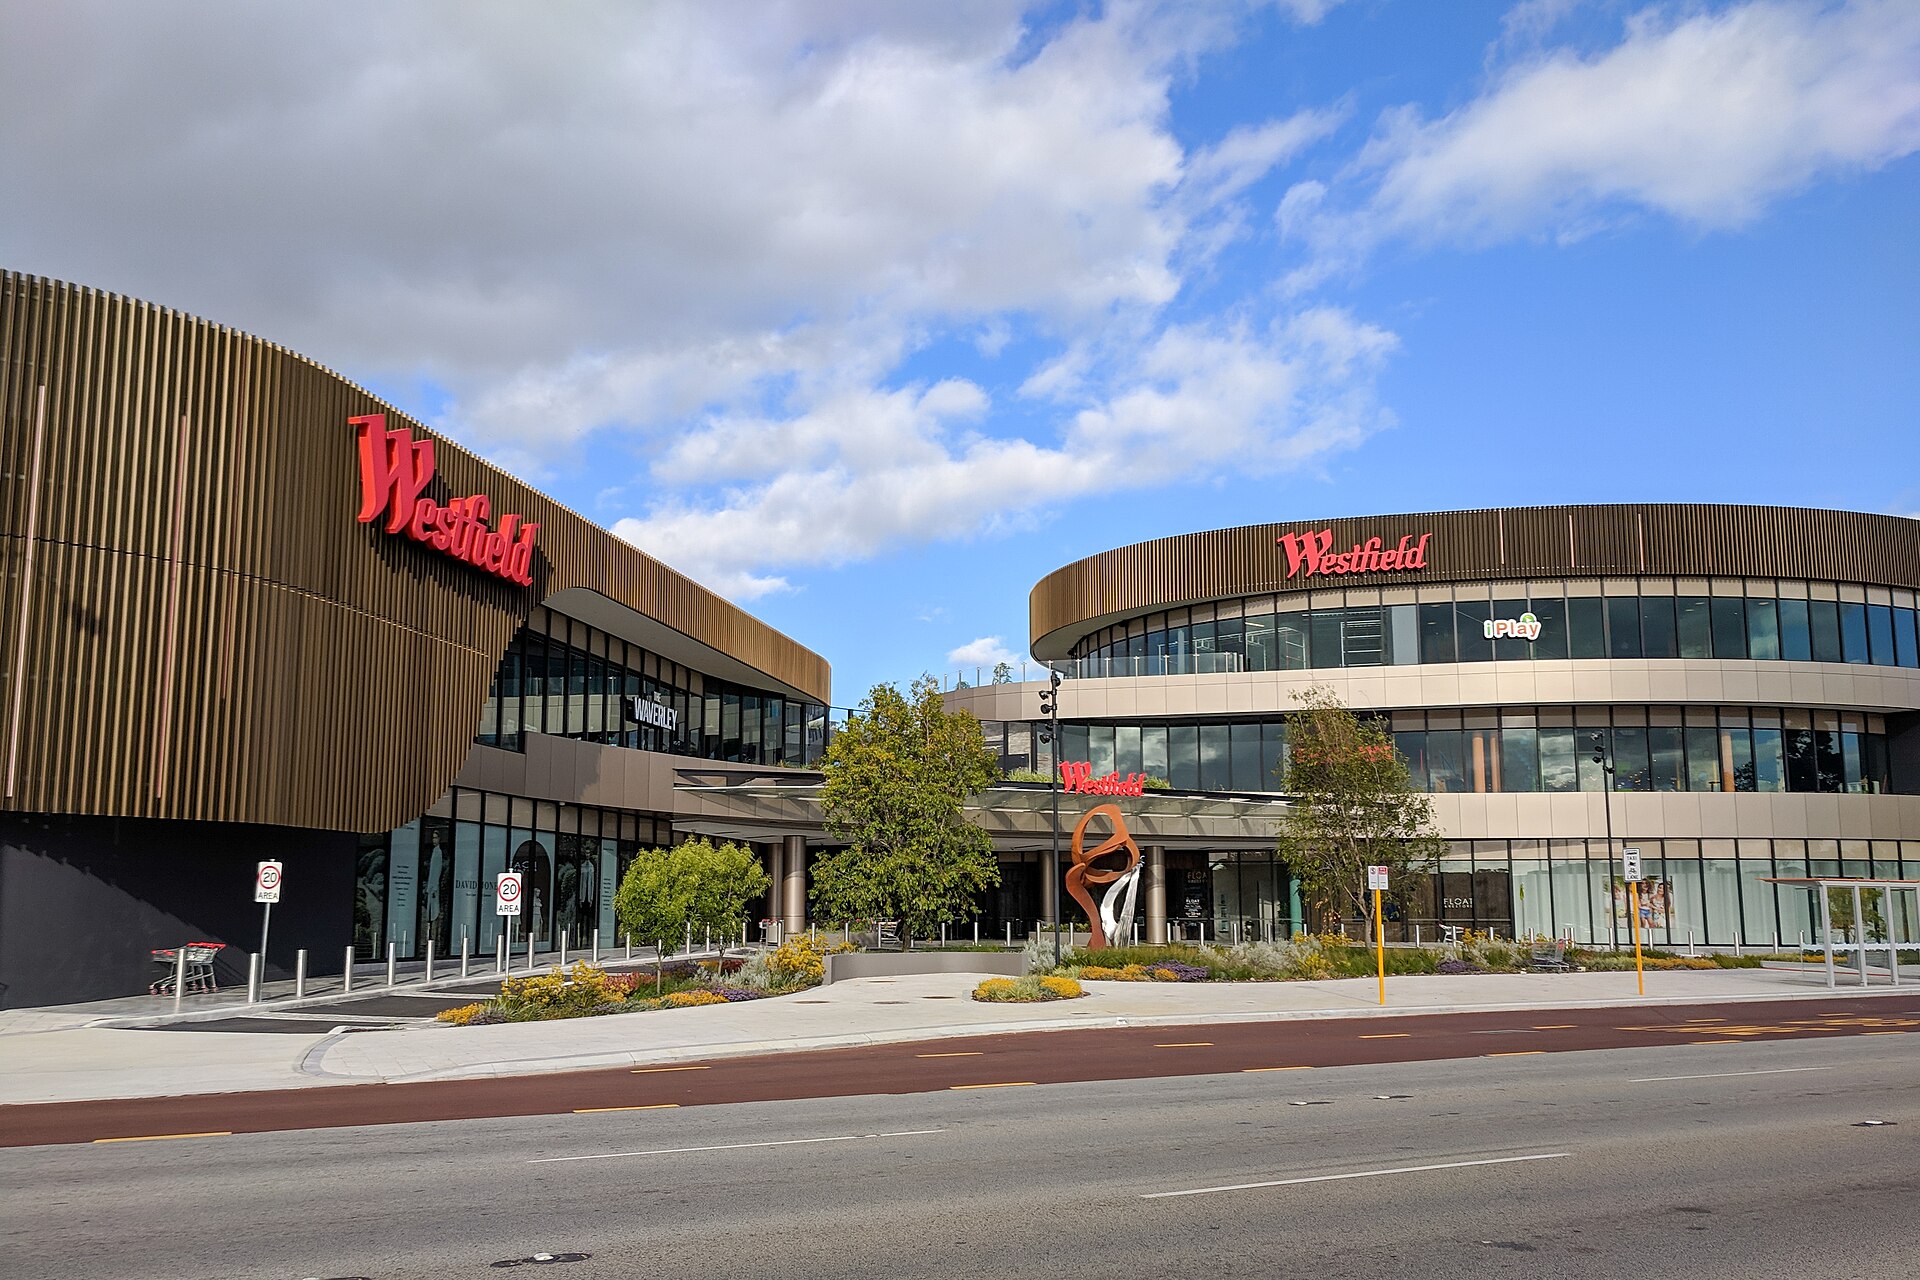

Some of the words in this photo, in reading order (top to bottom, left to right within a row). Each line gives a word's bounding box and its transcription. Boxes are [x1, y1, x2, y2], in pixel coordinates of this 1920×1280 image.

[348, 413, 541, 587] Westfield
[1276, 528, 1433, 579] Westfield
[1485, 620, 1540, 639] iPlay
[634, 696, 678, 731] WAVERLEY
[1057, 760, 1148, 797] Westfield
[263, 872, 277, 882] 20
[1187, 871, 1208, 880] FLOA
[455, 880, 478, 890] DAVID
[502, 884, 517, 895] 20
[258, 891, 278, 900] AREA
[1443, 897, 1473, 905] FLOAT
[498, 904, 519, 913] AREA
